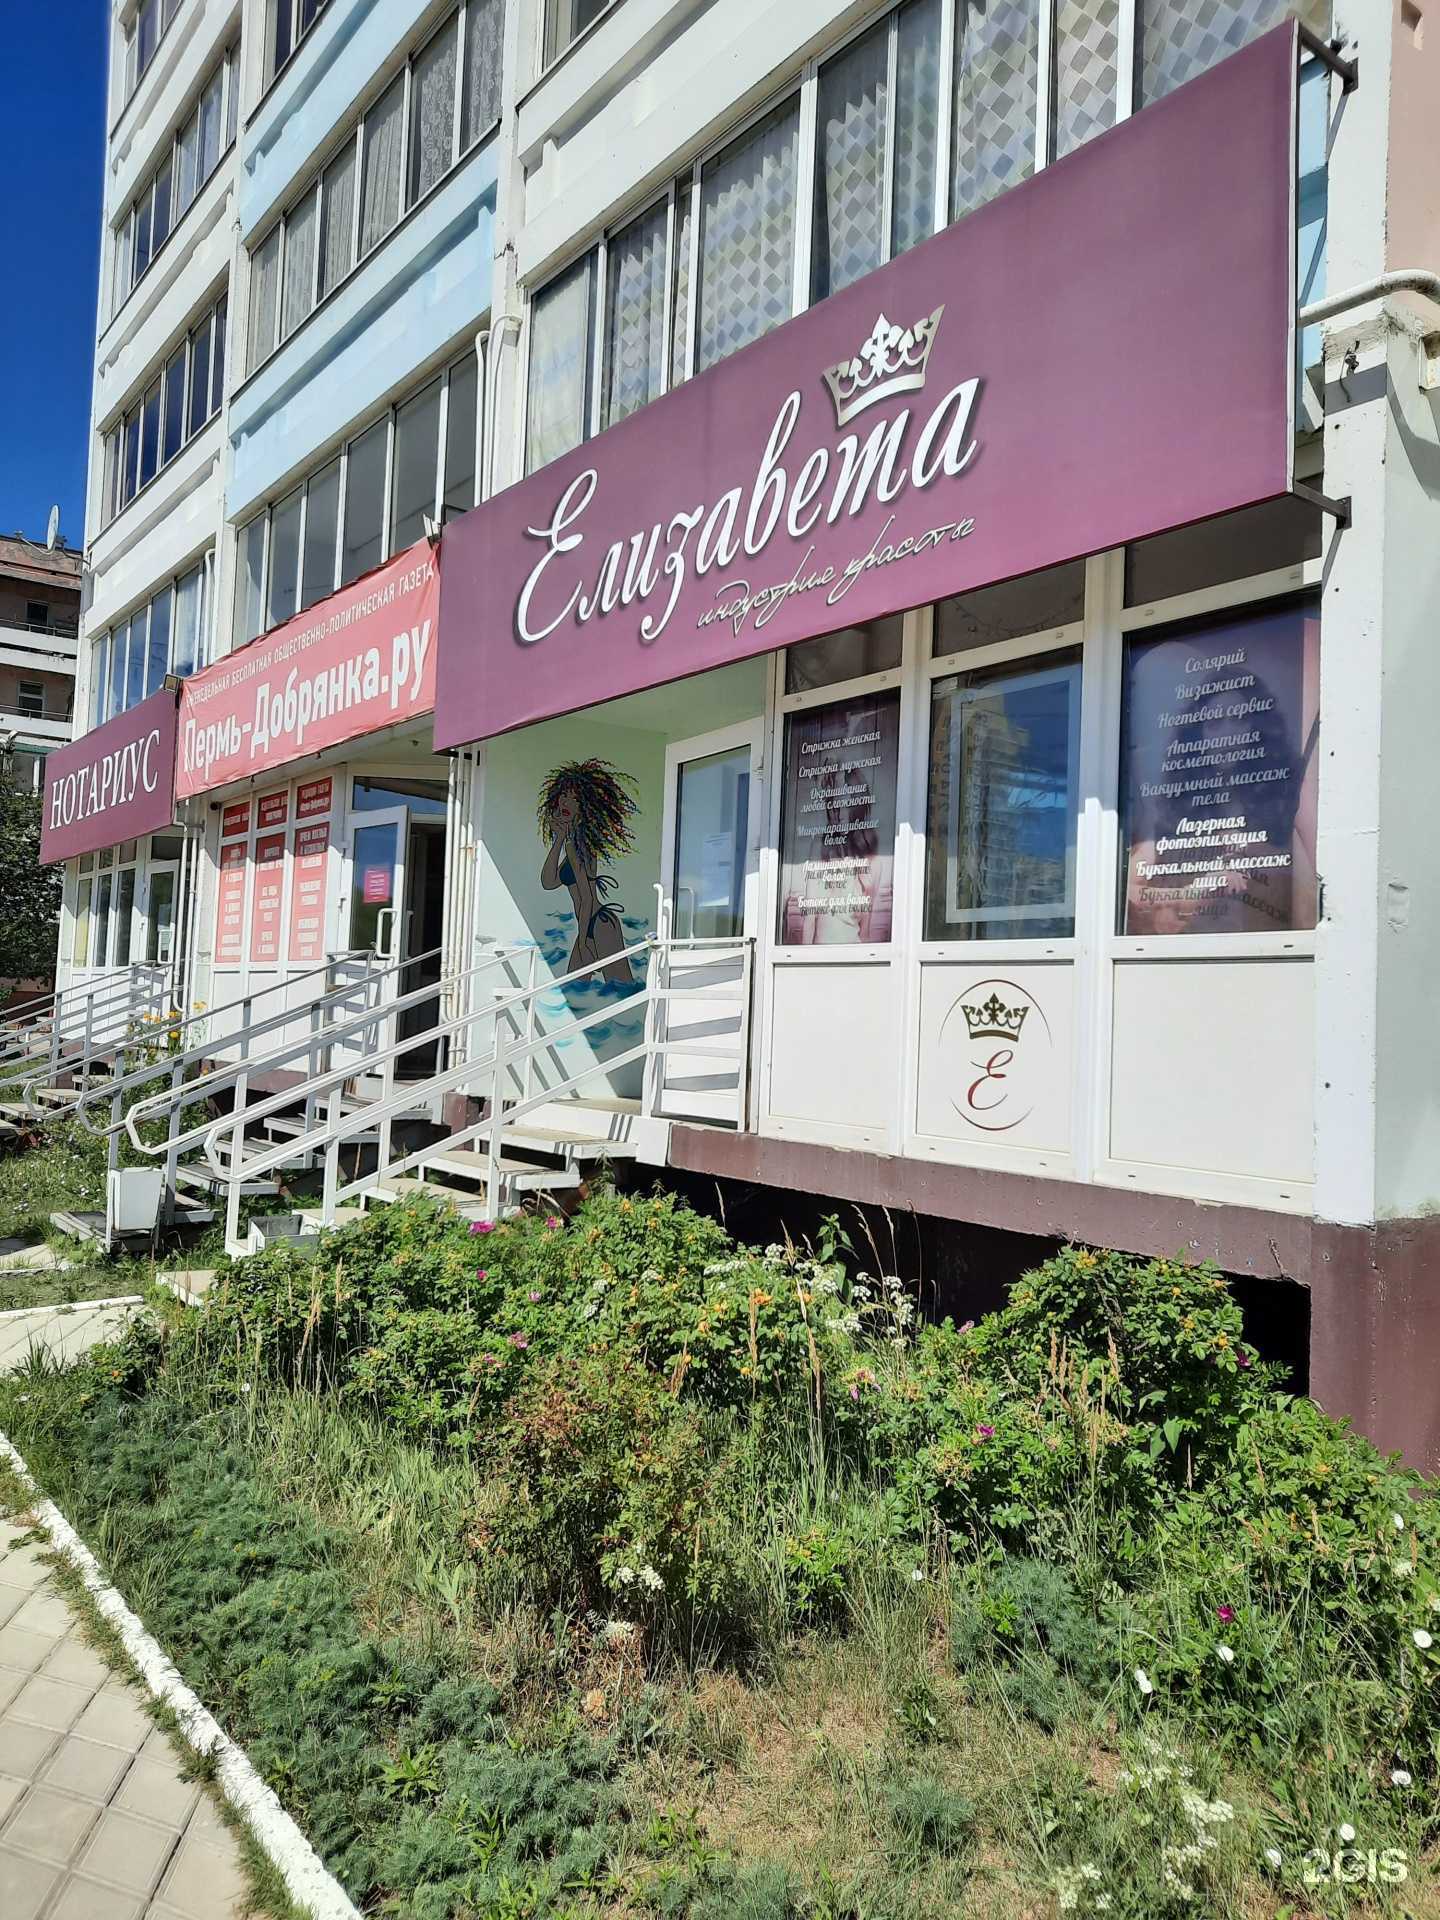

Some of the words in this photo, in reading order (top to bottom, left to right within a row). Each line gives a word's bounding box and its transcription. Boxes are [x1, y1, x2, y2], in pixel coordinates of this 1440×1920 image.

[517, 378, 980, 642] Елизавета
[232, 652, 272, 685] БЕСПЛАТНАЯ
[274, 584, 395, 663] ОБЩЕСТВЕННО-ПОЛИТИЧЕСКАЯ
[399, 561, 434, 596] ГАЗЕТА
[1185, 648, 1246, 674] Солярий
[183, 619, 432, 779] Пермь-Добрянка.ру
[1175, 675, 1255, 701] Визажист
[1158, 703, 1223, 728] Ногтевой
[1226, 697, 1273, 719] сервис
[802, 739, 840, 755] Стрижка
[842, 731, 880, 746] женская
[1167, 730, 1261, 757] Аппаратная
[799, 763, 838, 779] Стрижка
[840, 756, 881, 773] мужская
[1161, 747, 1265, 773] косметология
[49, 729, 160, 830] НОТАРИУС
[1140, 772, 1223, 798] Вакуумный
[1226, 767, 1290, 786] массаж
[827, 795, 875, 810] сложности
[1191, 792, 1231, 807] тела
[1175, 815, 1246, 836] Лазерная
[824, 834, 847, 846] волос
[1156, 830, 1268, 855] фотоэпиляция
[1136, 856, 1224, 880] Буккальный
[1226, 854, 1292, 870] массаж
[1190, 875, 1228, 892] лица
